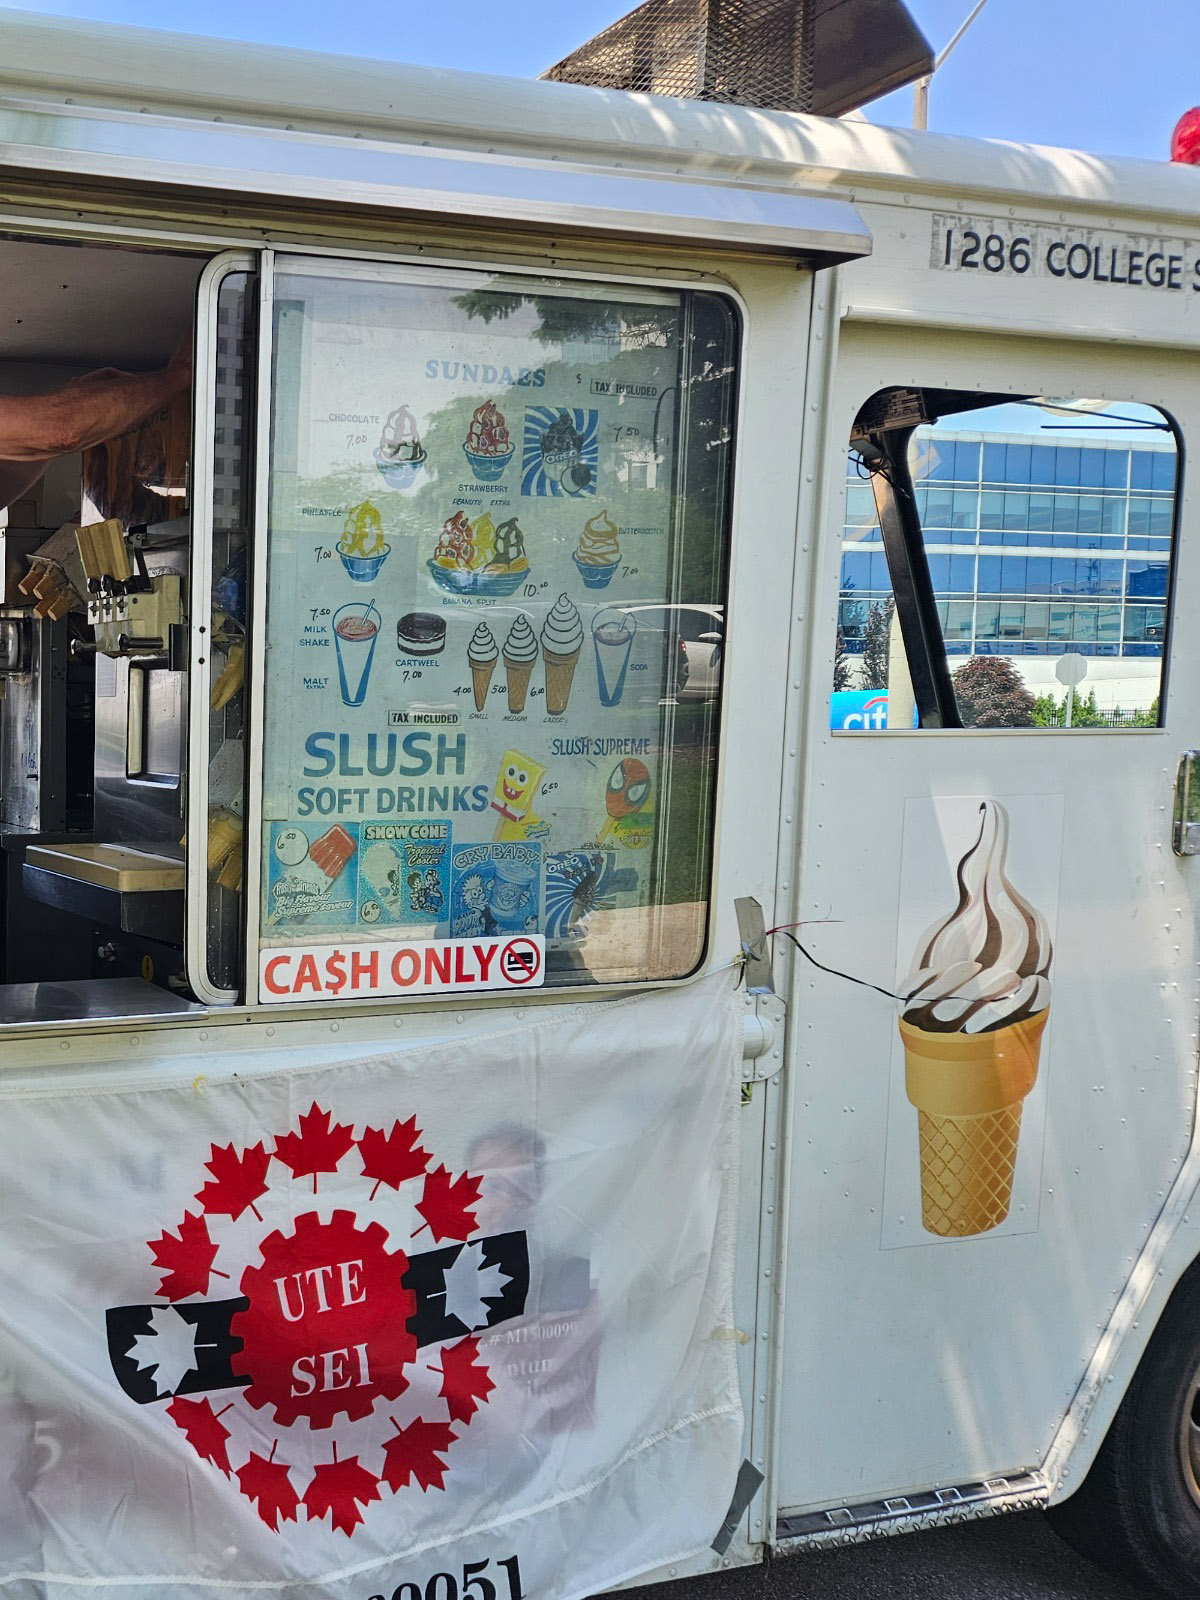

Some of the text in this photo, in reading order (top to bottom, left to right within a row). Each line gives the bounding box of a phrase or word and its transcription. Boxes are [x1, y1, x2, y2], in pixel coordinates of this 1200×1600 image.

[944, 230, 1031, 273] 1286
[1047, 242, 1183, 289] COLLEGE
[424, 359, 546, 388] SUNDAES
[595, 381, 657, 397] TAX INCLUDED
[329, 413, 380, 424] CHOCOLATE
[546, 450, 577, 464] OREO
[458, 484, 508, 493] STRAWBERRY
[452, 498, 482, 507] PEANUTS
[302, 507, 341, 518] PINEAPPLE
[443, 598, 472, 606] BANANA
[395, 659, 440, 667] CARTWEEL
[303, 677, 328, 685] MALT
[392, 712, 458, 724] TAX INCLUDED
[552, 738, 650, 755] SLUSH SUPREME
[303, 732, 466, 777] SLUSH
[297, 784, 489, 816] SOFT DRINKS
[364, 824, 448, 840] SNOW CONE
[404, 843, 446, 856] Tropical
[454, 843, 538, 868] CRY BABY
[407, 855, 441, 867] Cooler
[547, 856, 579, 874] OREO
[295, 892, 332, 904] Flavour
[319, 901, 353, 912] saveur
[263, 944, 500, 996] CA$H ONLY
[273, 1259, 367, 1322] UTE
[291, 1343, 373, 1398] SEI
